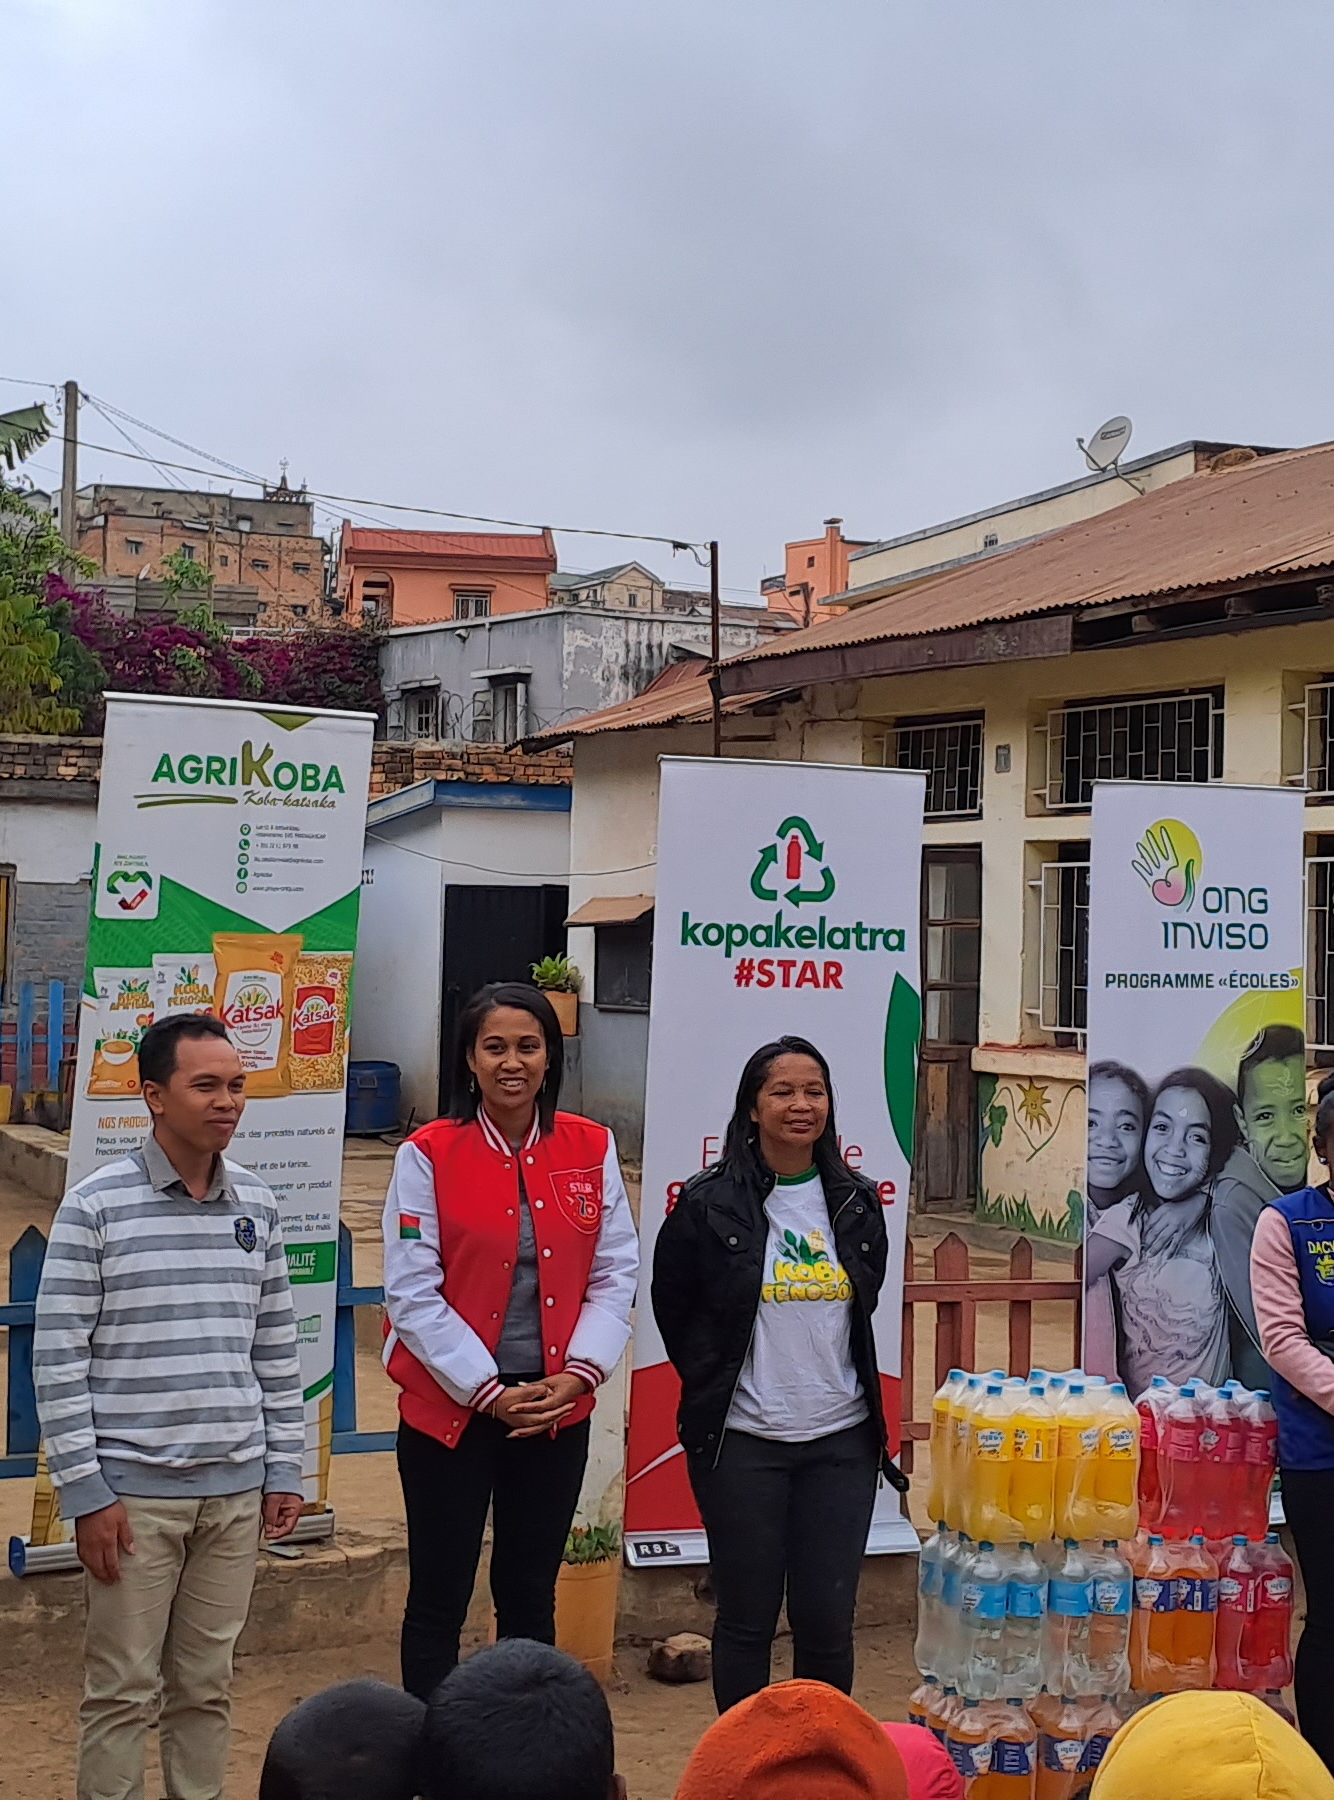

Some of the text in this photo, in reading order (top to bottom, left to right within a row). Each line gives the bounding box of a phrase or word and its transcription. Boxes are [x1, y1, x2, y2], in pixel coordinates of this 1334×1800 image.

[151, 740, 345, 793] AGRIKOBA
[681, 909, 906, 958] kopakelatra
[1161, 921, 1269, 950] INVISO
[734, 957, 843, 989] #STAR
[1105, 973, 1214, 988] PROGRAMME
[220, 999, 284, 1029] Katsak
[293, 1007, 337, 1028] Katsak
[288, 1249, 316, 1267] ALITÉ
